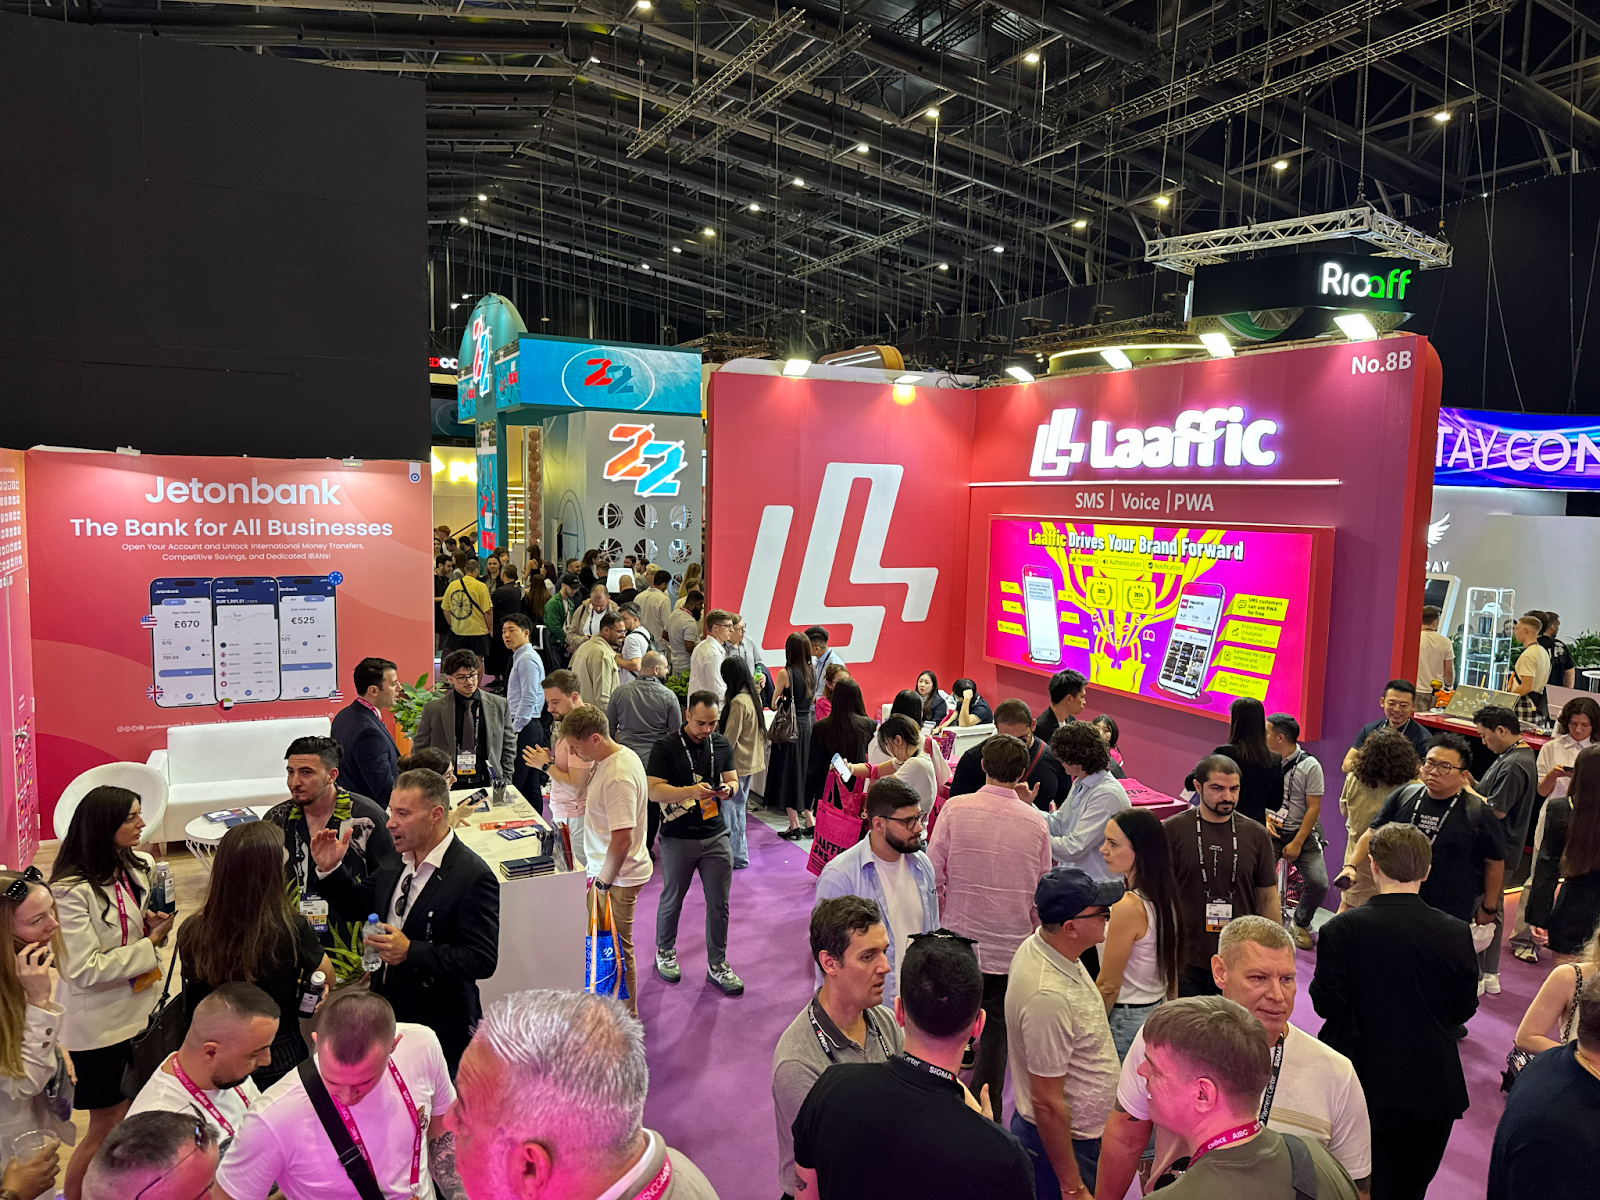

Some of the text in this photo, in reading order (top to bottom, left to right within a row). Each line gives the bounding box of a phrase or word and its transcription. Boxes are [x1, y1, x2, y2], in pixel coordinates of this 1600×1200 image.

[1351, 350, 1412, 375] No.8B
[1089, 406, 1278, 469] Laaffic
[145, 476, 342, 505] Jetonbank
[1075, 492, 1105, 509] SMS
[1122, 492, 1160, 510] Voice
[1174, 493, 1215, 512] PWA
[70, 517, 393, 537] The Bank for All Businesses
[122, 543, 146, 552] Open
[251, 542, 300, 550] International
[302, 543, 327, 551] Money
[329, 542, 365, 550] Transfers,
[1028, 528, 1245, 562] Laaffic Drives Your Brand Forward
[162, 553, 212, 562] Competitive
[214, 553, 247, 562] Savings,
[266, 552, 307, 560] Dedicated
[308, 552, 331, 560] IBANs!
[1108, 558, 1142, 568] Authentication
[1154, 561, 1183, 571] Notification
[1259, 598, 1283, 606] customers
[174, 619, 200, 628] £670
[291, 616, 315, 625] €525
[929, 1065, 954, 1081] SIGMA
[1260, 1045, 1283, 1120] Payment Center SIGMA
[1232, 1128, 1249, 1140] AIBC
